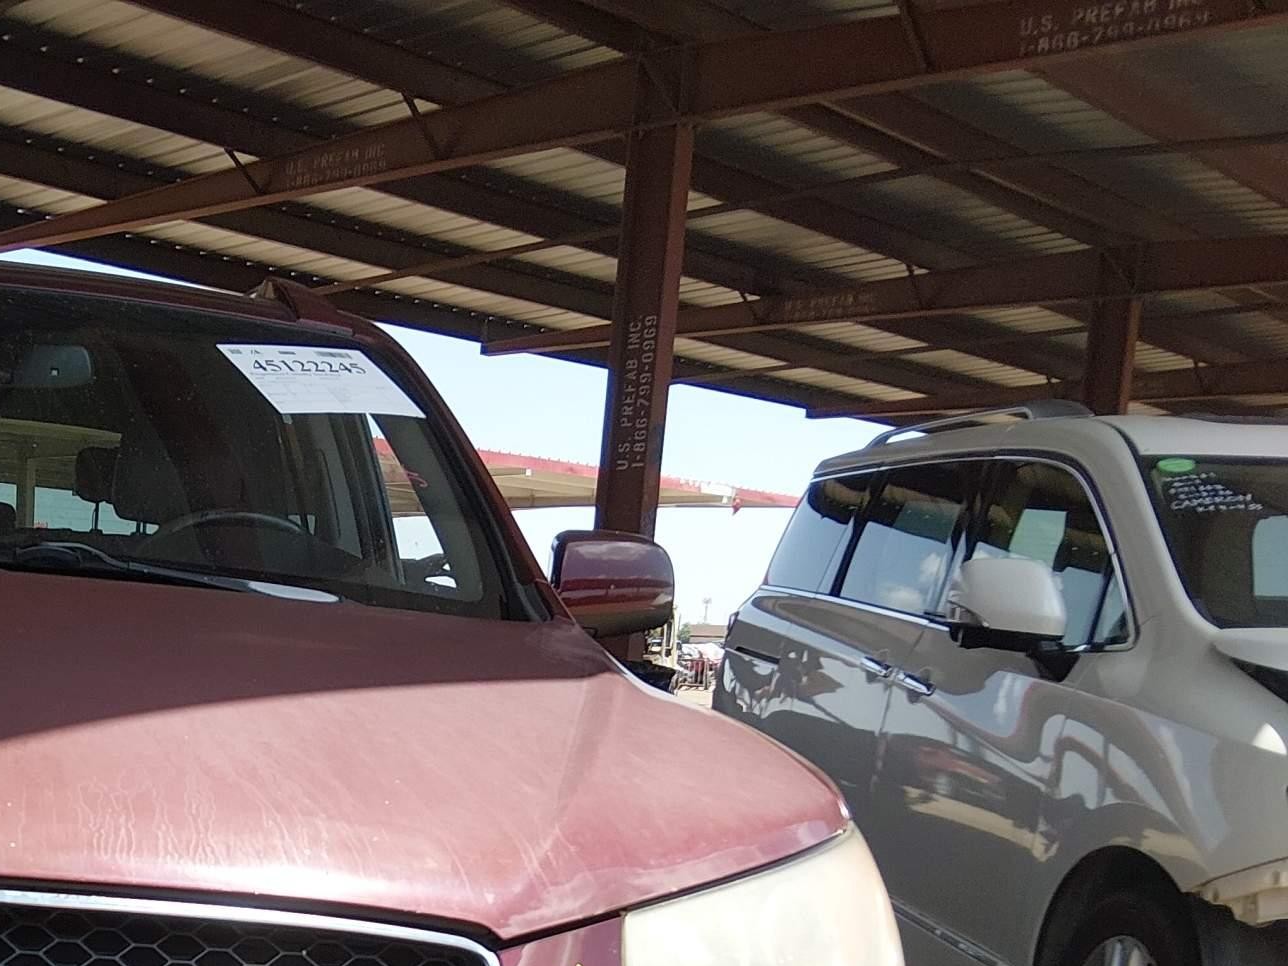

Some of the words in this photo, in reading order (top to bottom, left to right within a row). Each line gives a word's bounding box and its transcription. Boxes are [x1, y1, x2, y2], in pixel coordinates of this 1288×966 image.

[253, 359, 367, 375] 45122245
[621, 358, 638, 428] PREFAB
[631, 314, 658, 468] 1-866-799-0969
[616, 437, 632, 471] U.S.
